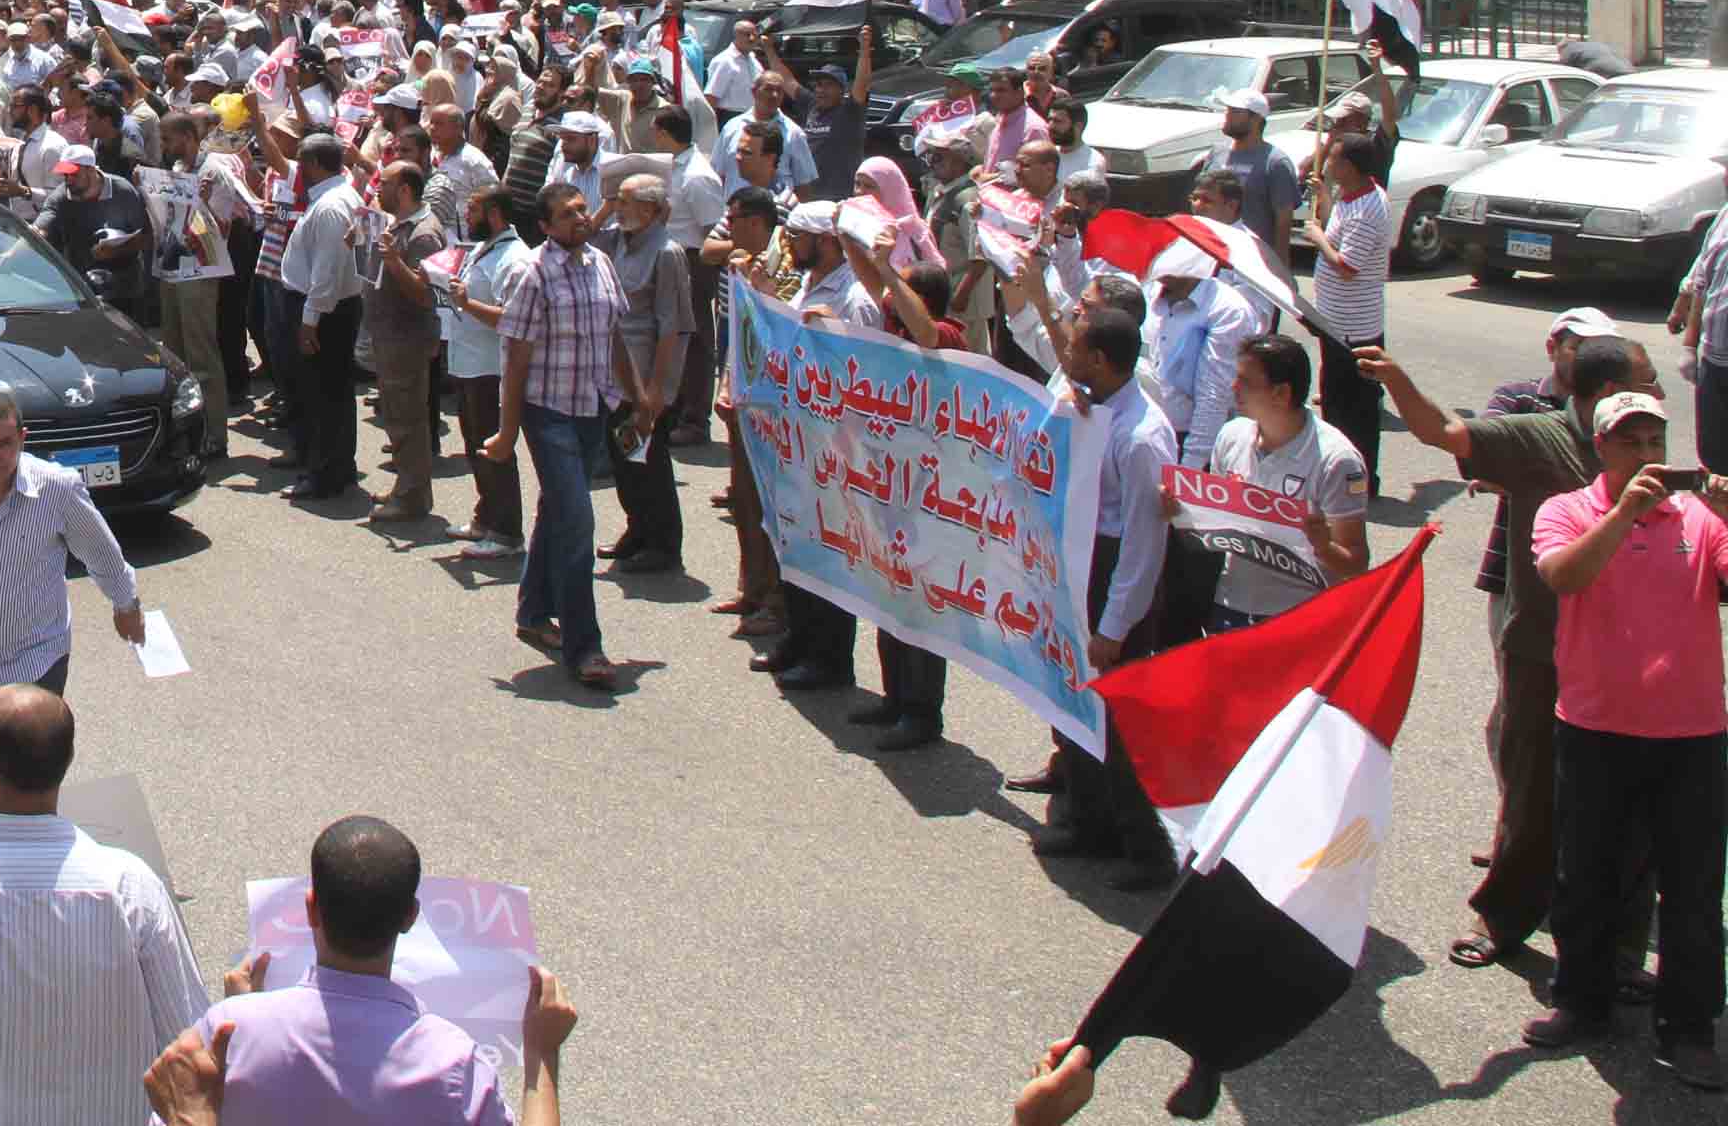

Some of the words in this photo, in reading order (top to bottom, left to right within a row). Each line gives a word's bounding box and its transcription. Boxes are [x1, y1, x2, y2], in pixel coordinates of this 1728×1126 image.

[935, 99, 969, 120] CC
[795, 345, 929, 439] البيطريين
[814, 445, 913, 510] الحرس
[1173, 470, 1229, 505] No
[1242, 488, 1304, 523] CC
[1190, 531, 1246, 554] Yes
[921, 559, 986, 620] على
